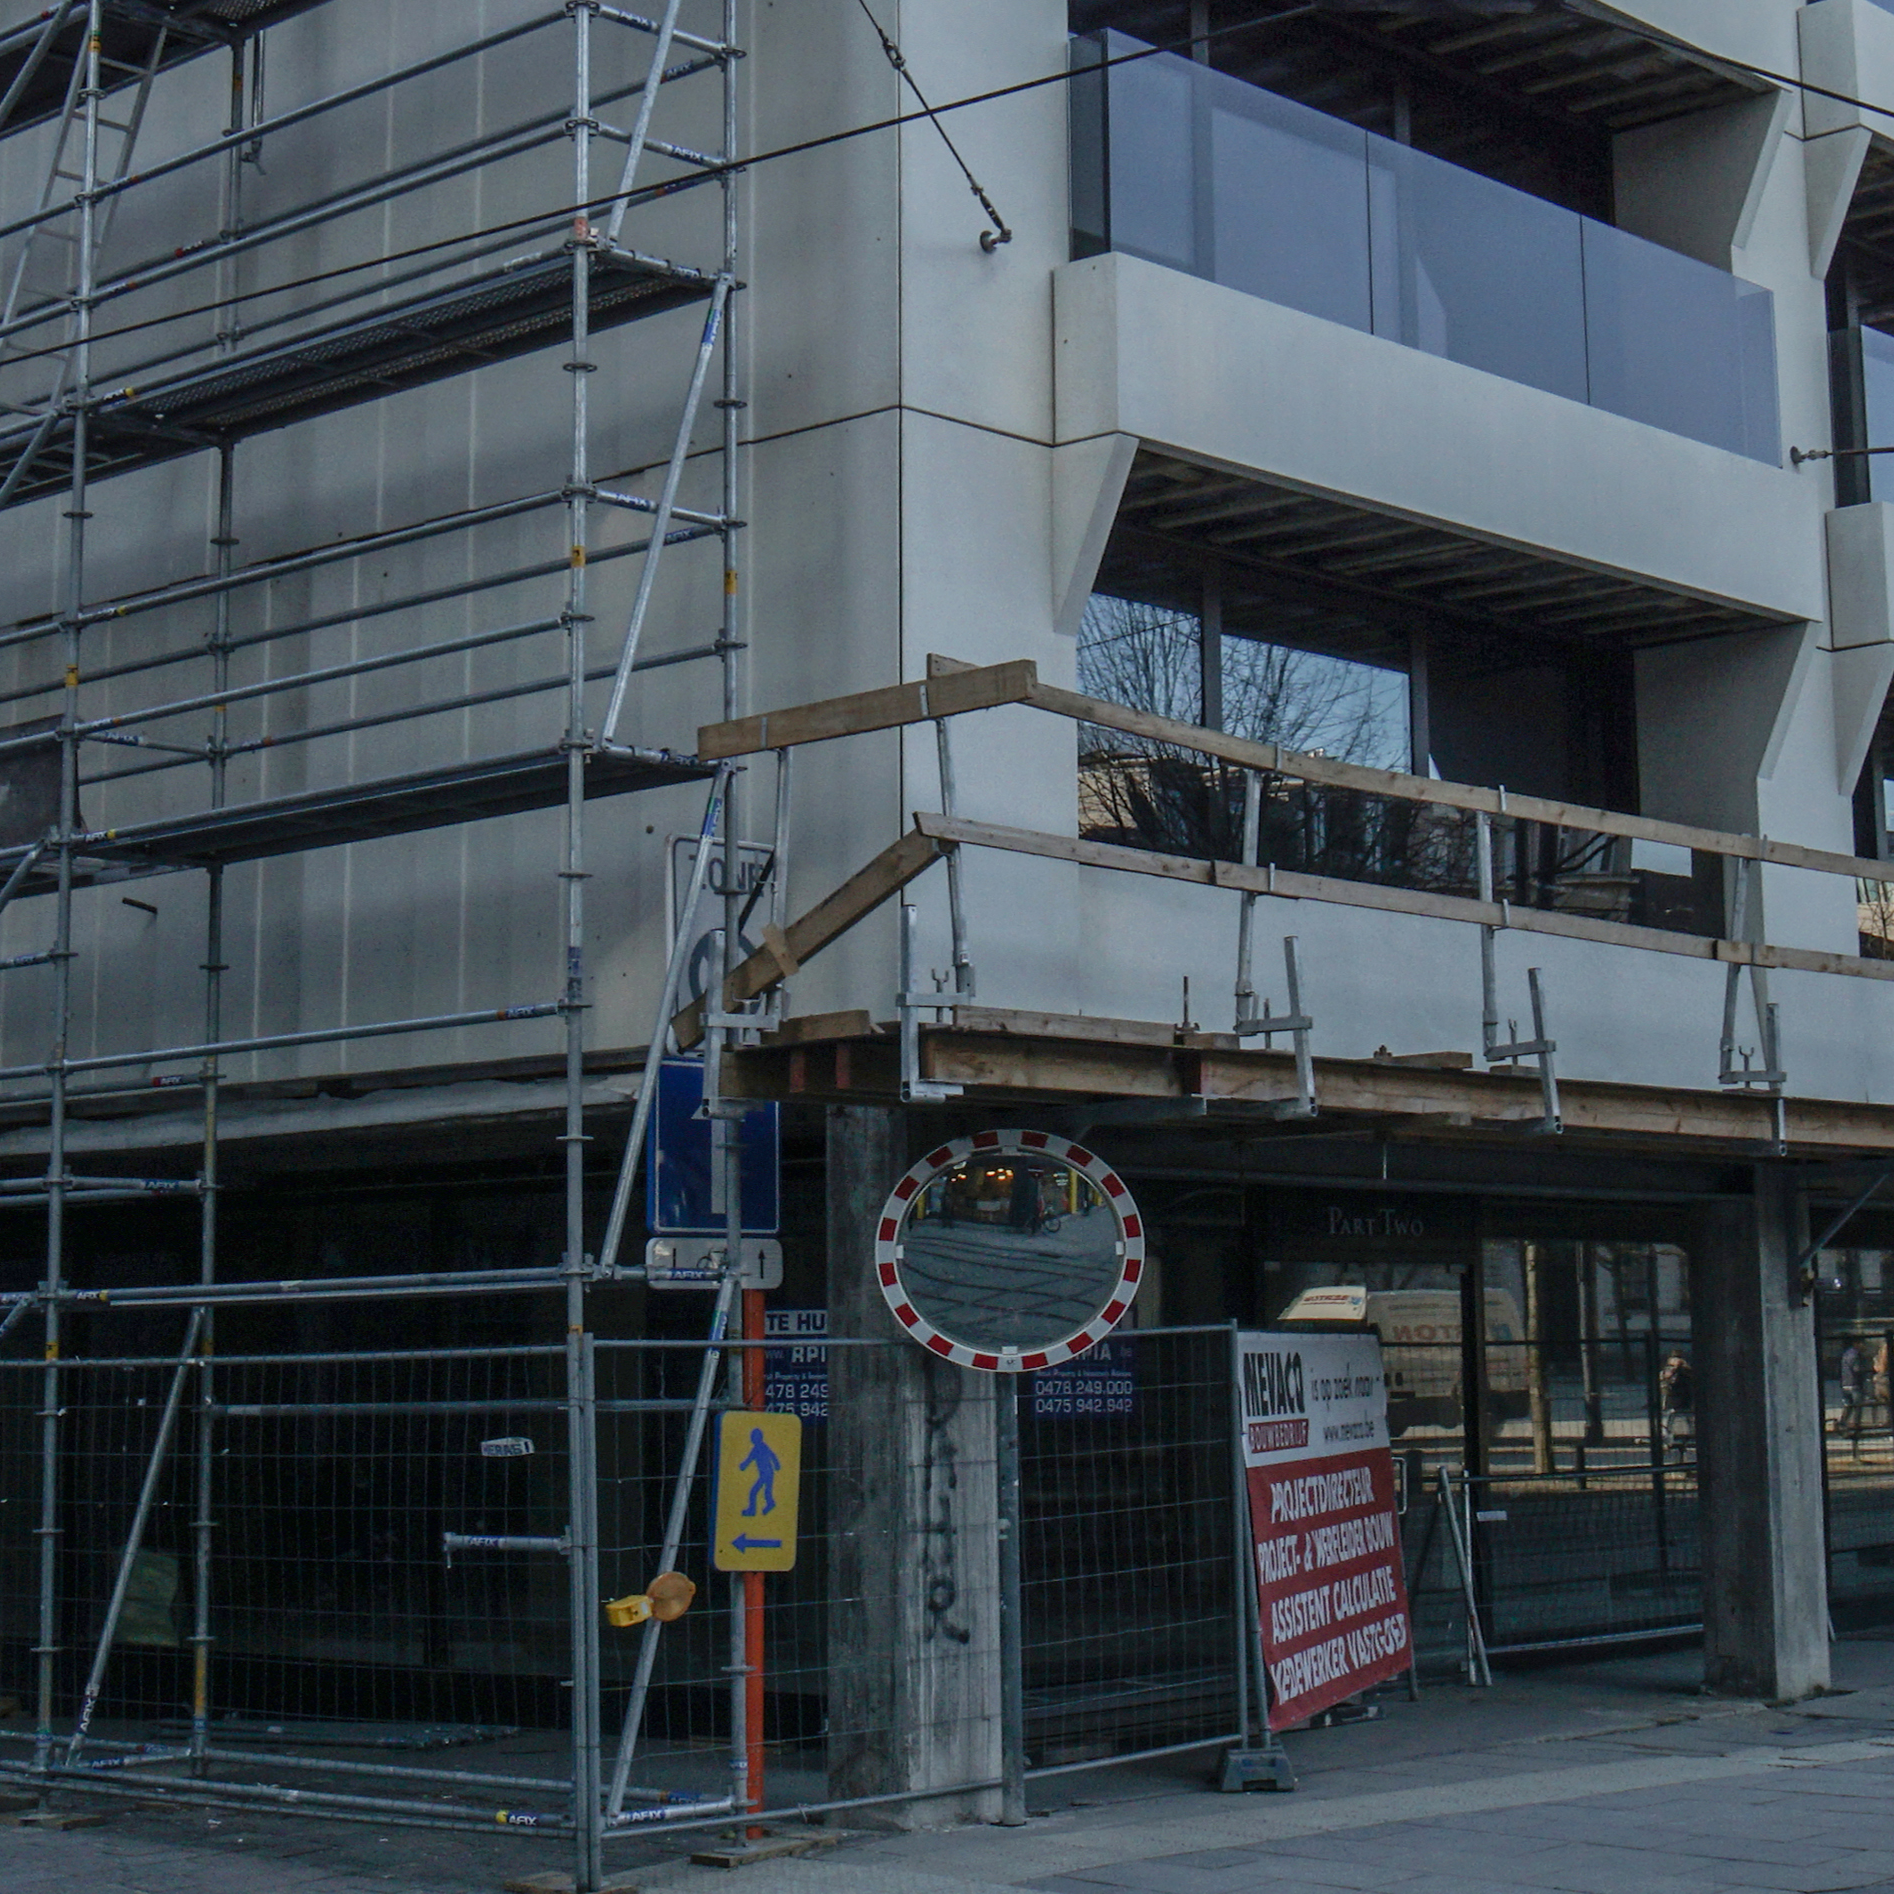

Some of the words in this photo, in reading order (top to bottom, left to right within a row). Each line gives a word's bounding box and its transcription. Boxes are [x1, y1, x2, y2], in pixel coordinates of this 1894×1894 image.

[766, 1313, 789, 1331] TE
[797, 1313, 826, 1331] HU
[791, 1346, 827, 1363] RPI
[1035, 1398, 1073, 1413] 0475
[1270, 1466, 1375, 1524] PROJECTDIRECTEUR
[1258, 1534, 1301, 1586] PROJECT-
[1304, 1532, 1314, 1572] &
[1363, 1511, 1394, 1553] BOUW
[1271, 1585, 1332, 1645] ASSISTENT
[1333, 1565, 1397, 1621] CALCULATIE
[509, 1813, 539, 1827] AFIX
